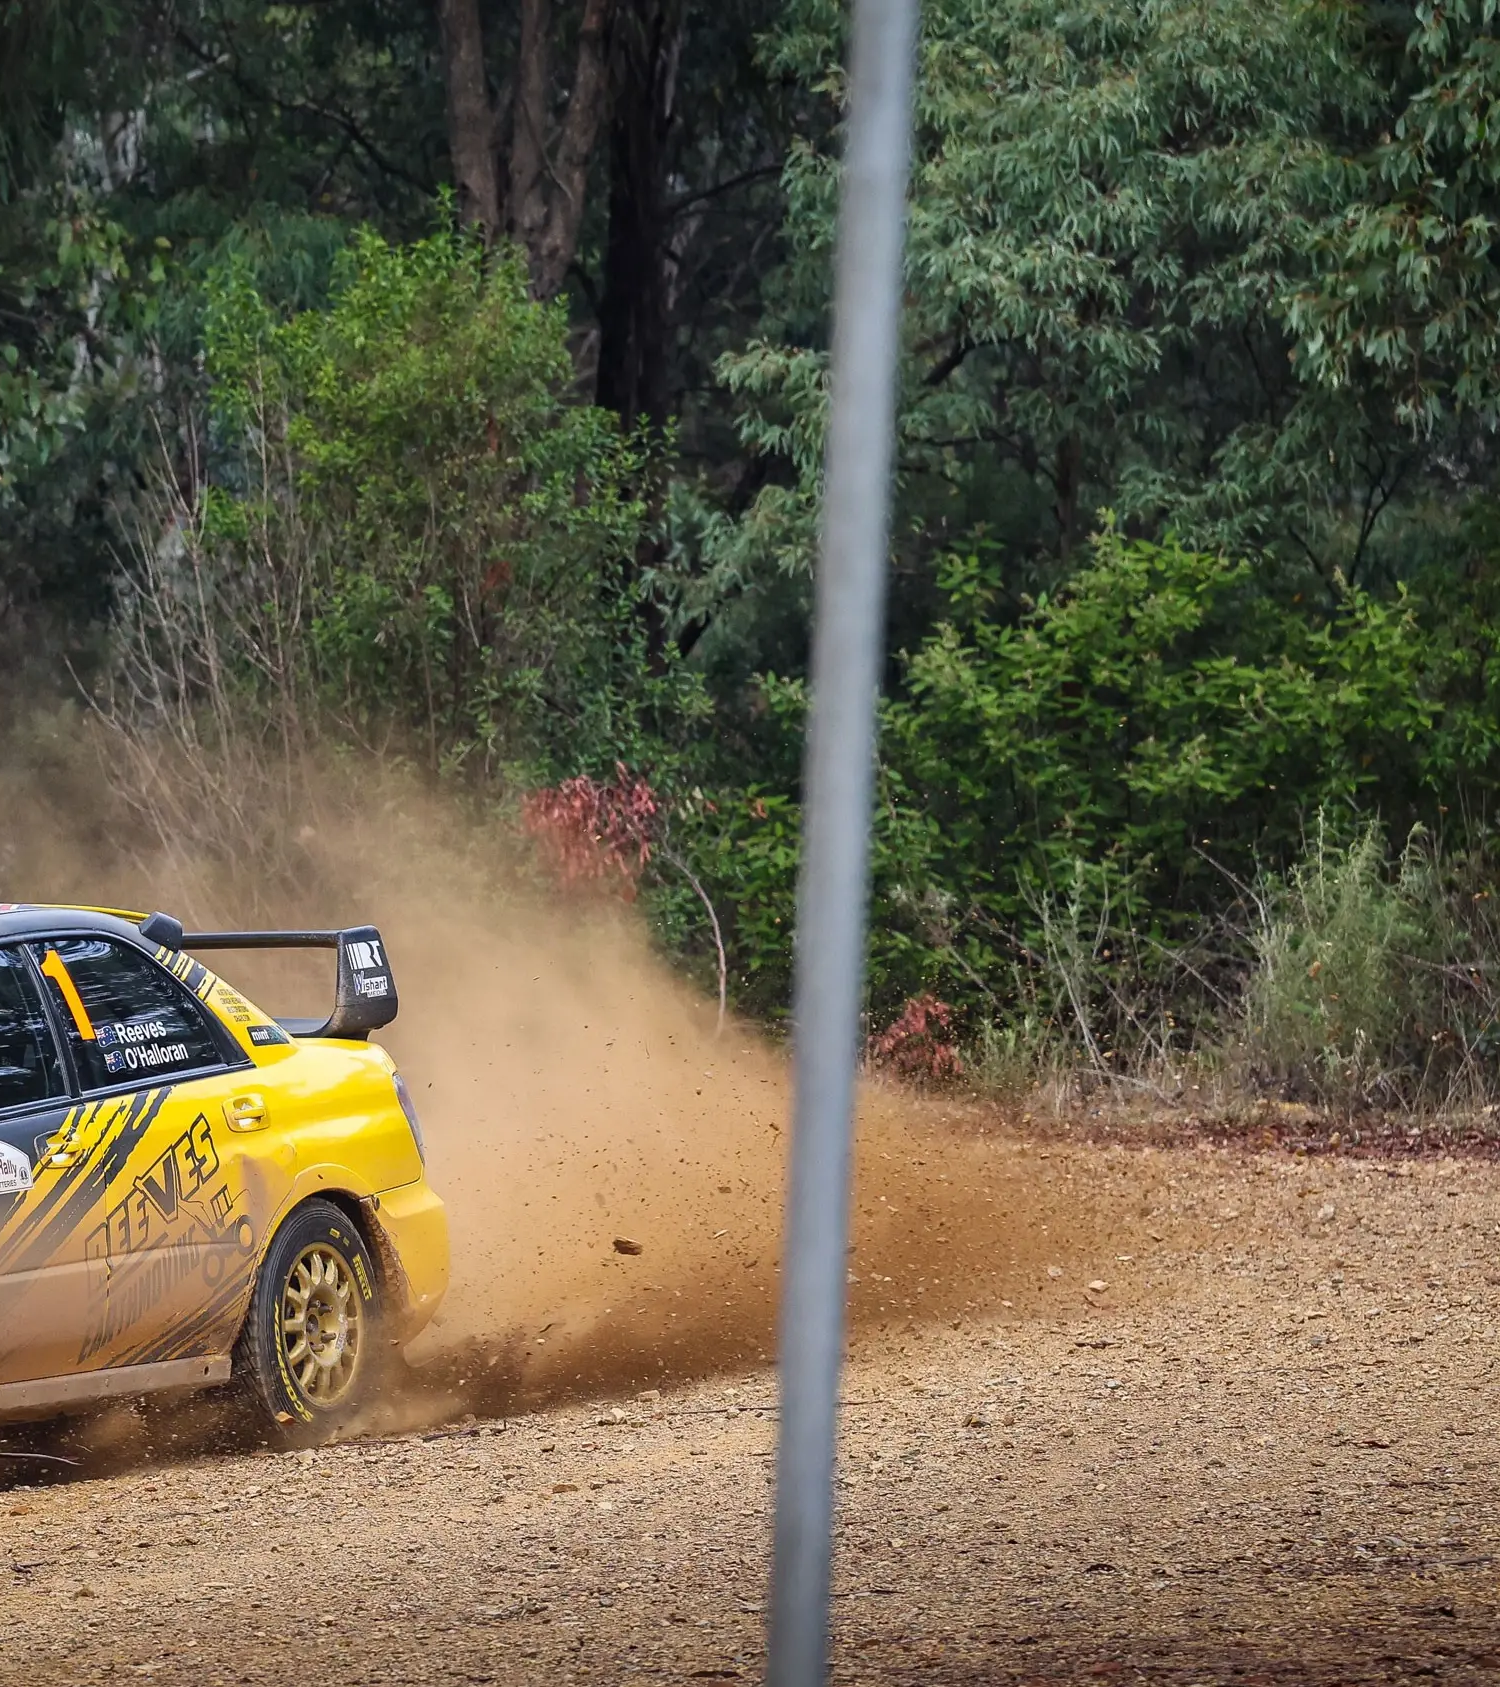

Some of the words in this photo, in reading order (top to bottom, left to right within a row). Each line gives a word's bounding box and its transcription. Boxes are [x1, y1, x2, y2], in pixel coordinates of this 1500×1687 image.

[40, 949, 96, 1040] 1
[352, 970, 388, 996] Wishart
[113, 1020, 168, 1045] Reeves
[124, 1042, 190, 1070] O'Halloran
